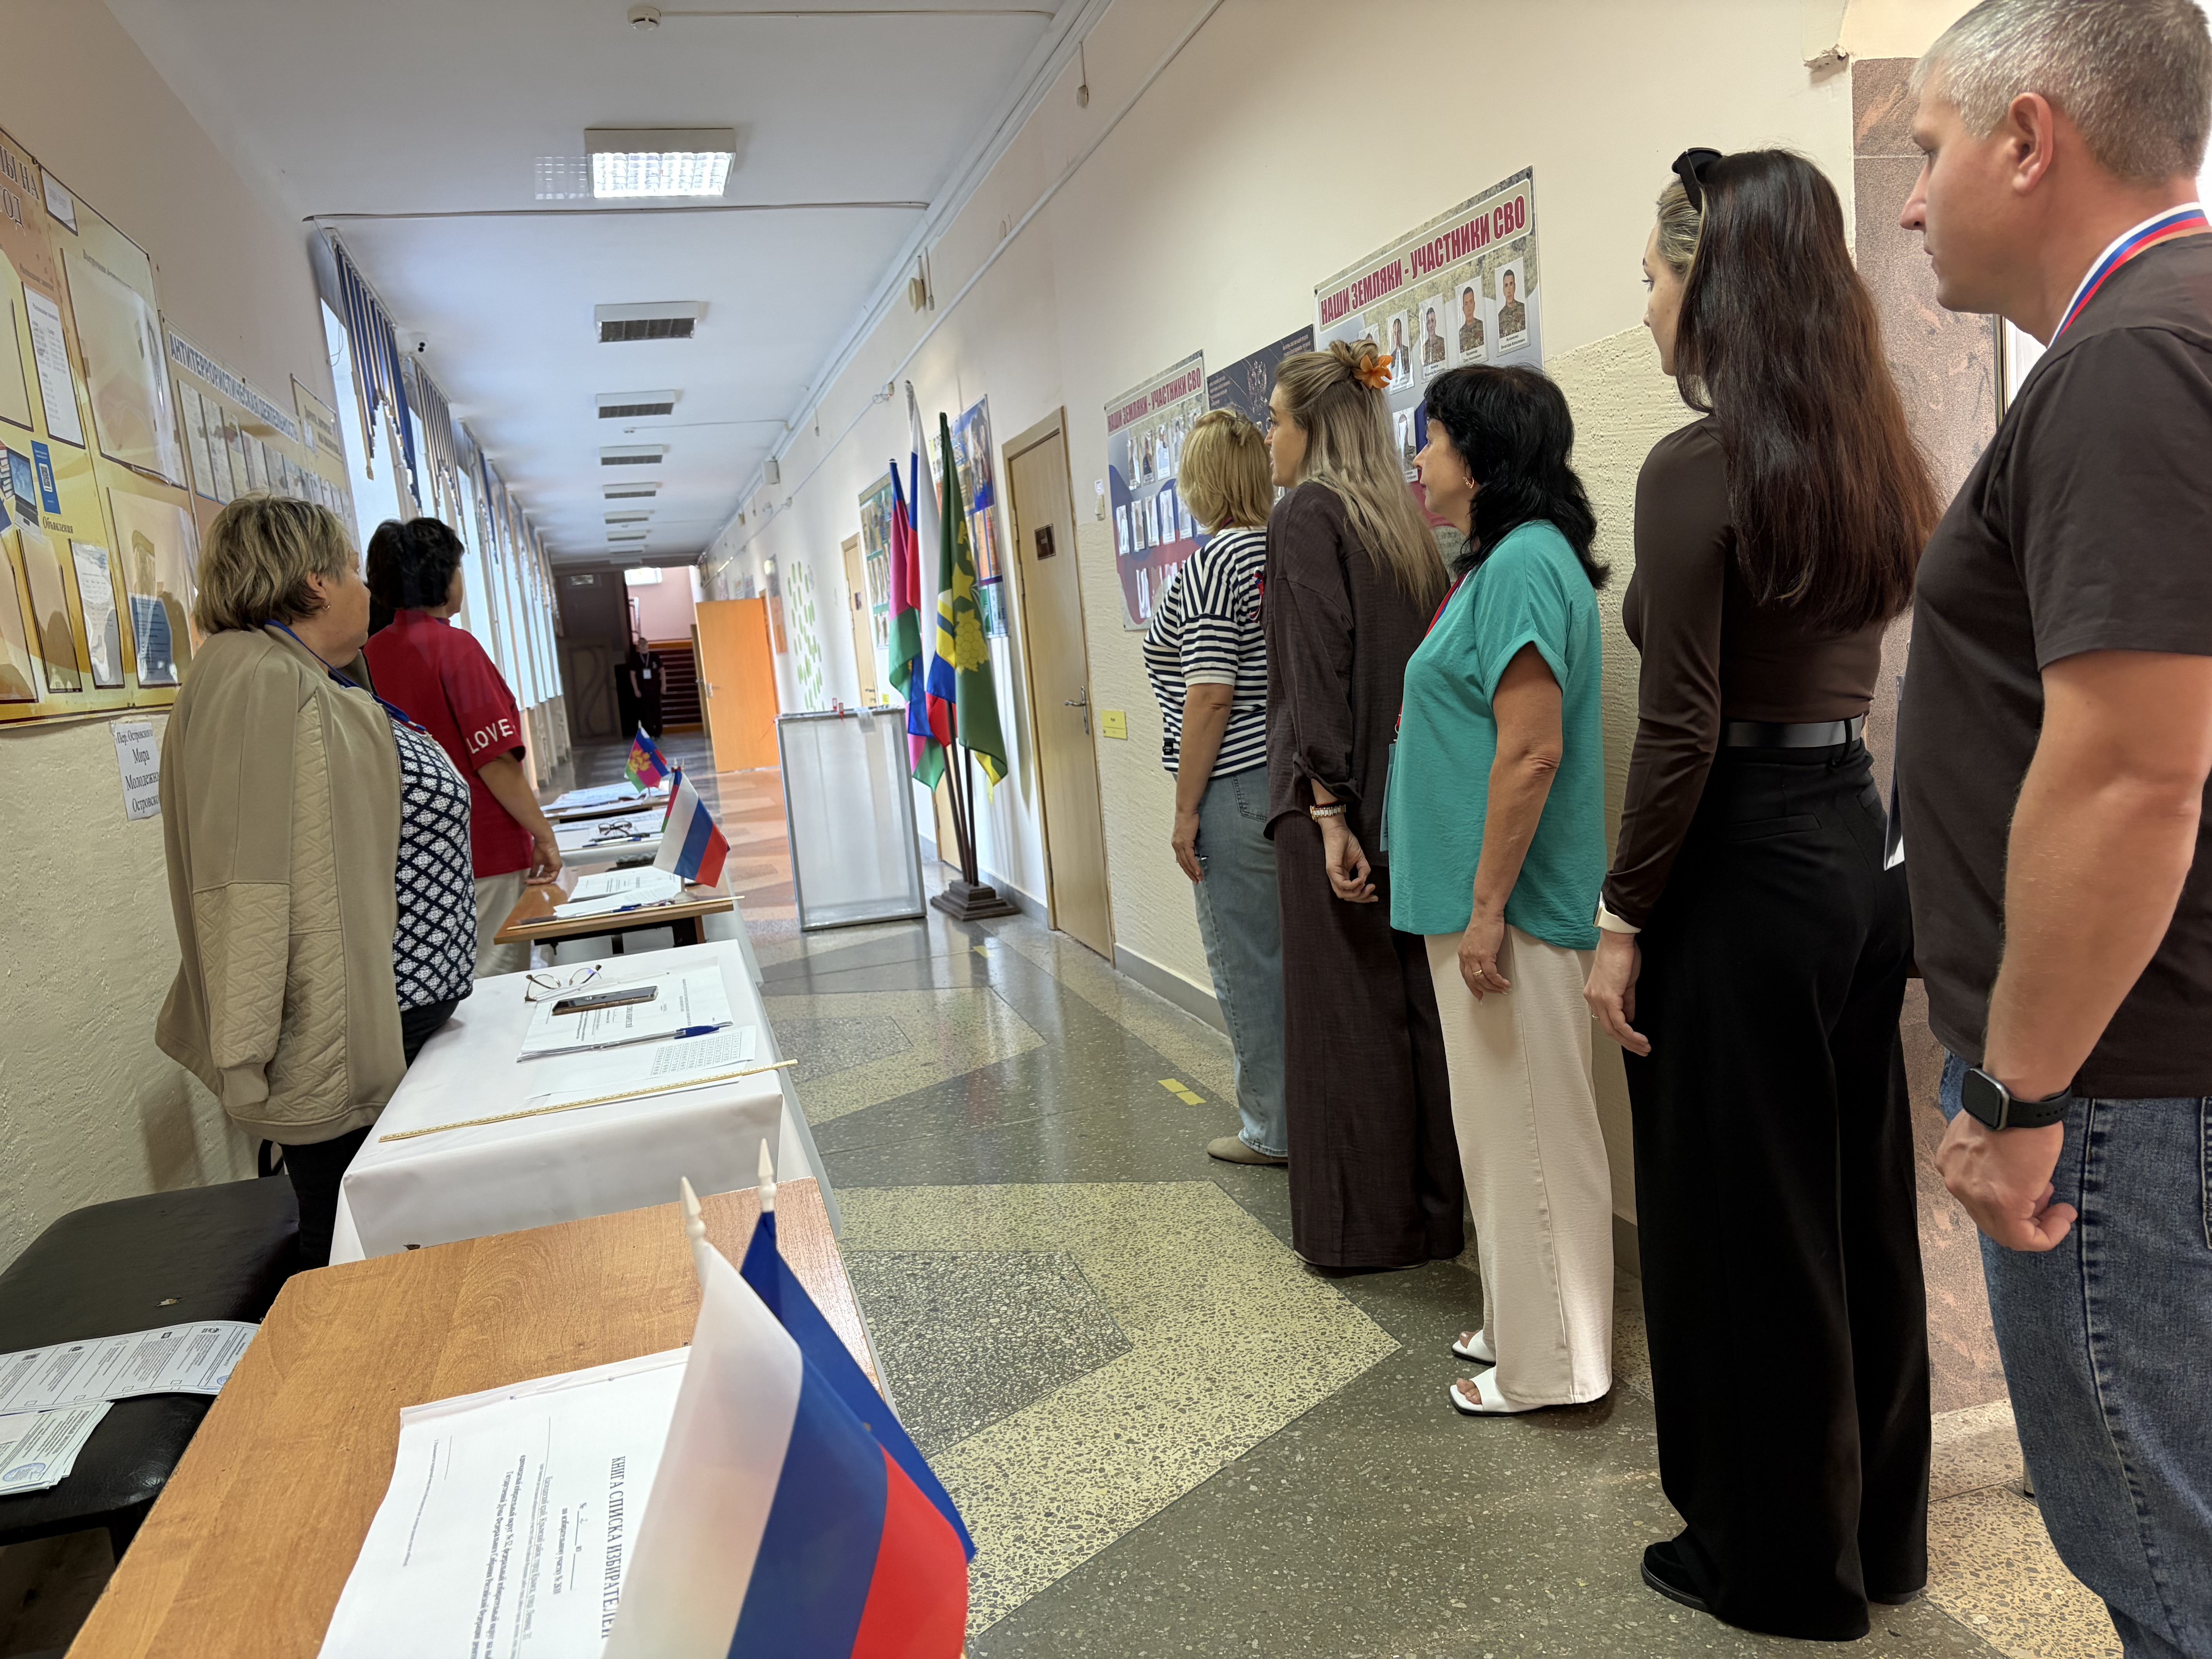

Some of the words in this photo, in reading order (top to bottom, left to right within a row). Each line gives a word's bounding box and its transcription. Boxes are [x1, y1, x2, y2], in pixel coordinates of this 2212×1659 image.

[0, 185, 24, 228] ОД
[1321, 287, 1350, 326] НАШИ
[1351, 258, 1403, 309] ЗЕМЛЯКИ
[1410, 212, 1490, 280] УЧАСТНИКИ
[1493, 196, 1525, 239] СВО
[1151, 375, 1187, 410] УЧАСТНИКИ
[1187, 367, 1201, 392] СВО
[43, 516, 73, 534] Объявления
[117, 732, 129, 745] Пер.
[467, 718, 513, 754] LOVE
[132, 748, 150, 766] Мира
[610, 1455, 625, 1489] КНИГА
[608, 1491, 623, 1543] СПИСКА
